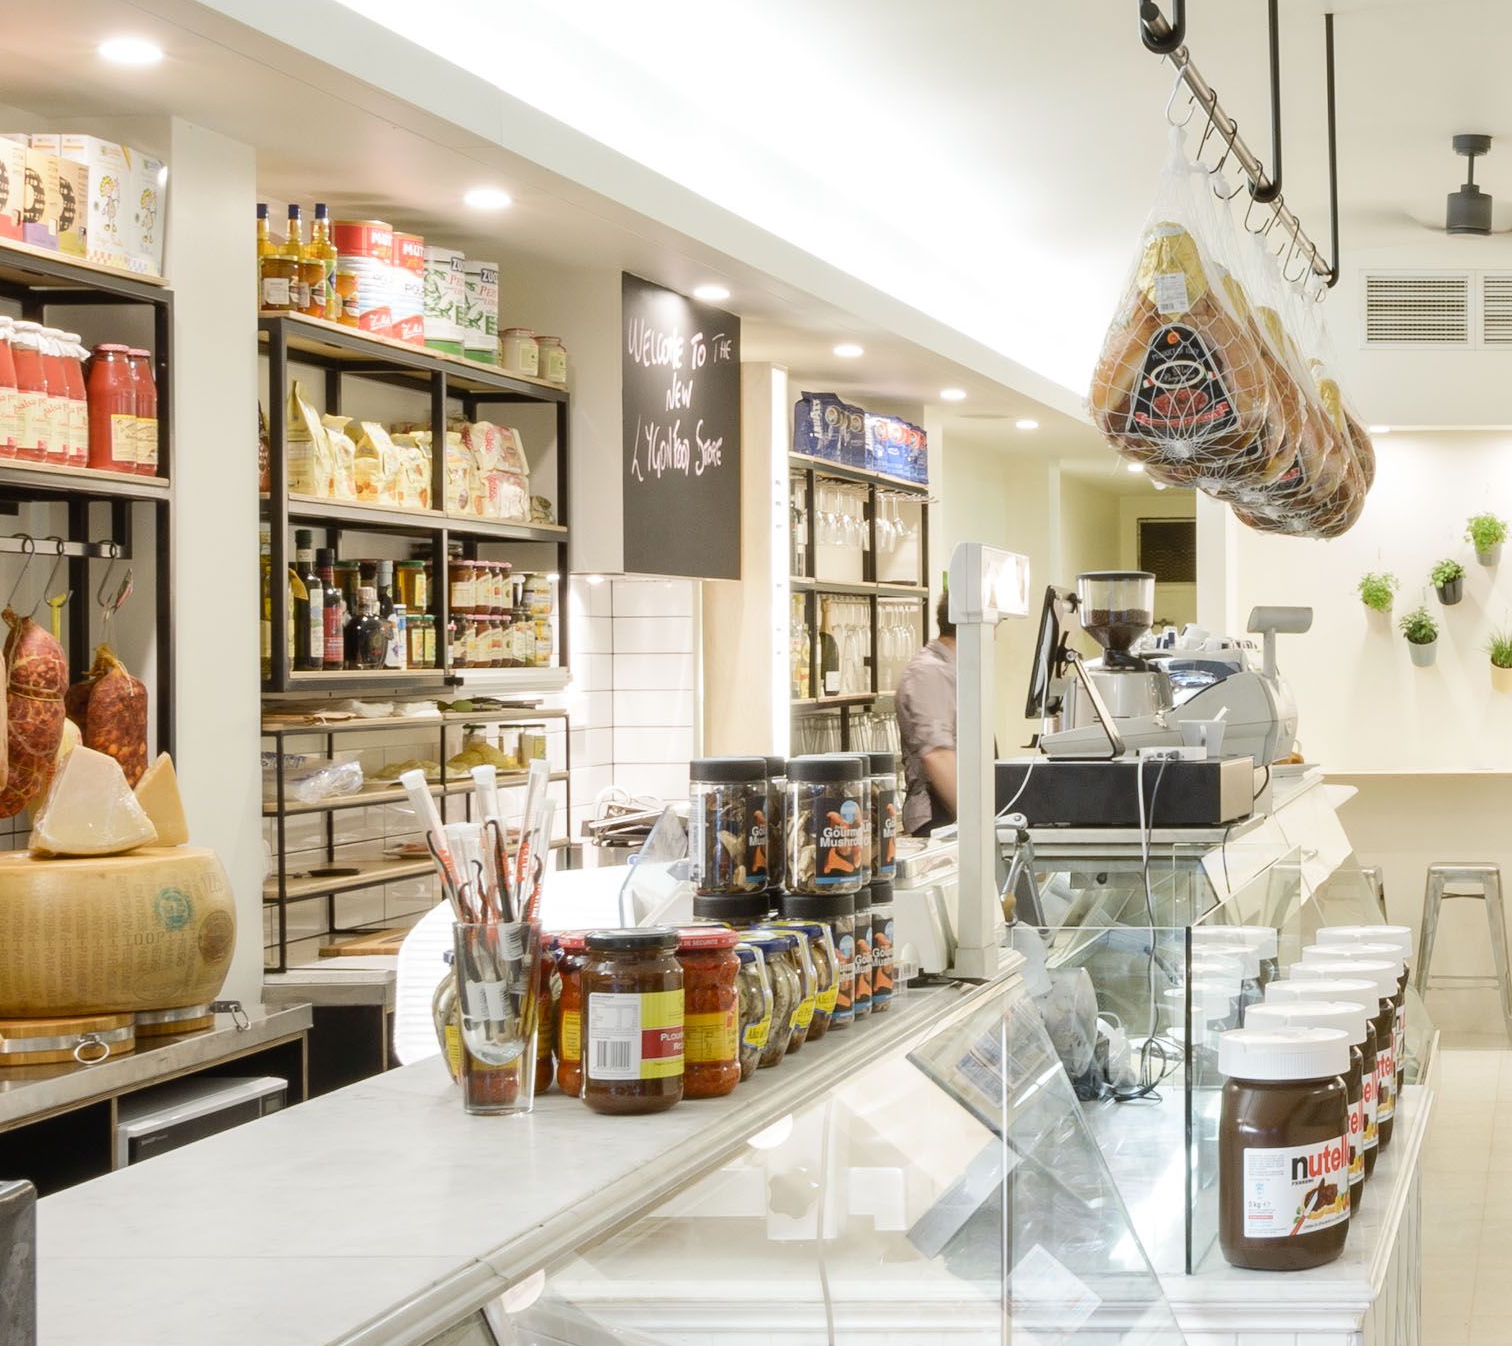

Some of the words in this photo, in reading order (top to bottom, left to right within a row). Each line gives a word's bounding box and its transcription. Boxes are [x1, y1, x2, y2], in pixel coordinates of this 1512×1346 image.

[628, 317, 684, 370] WELCOME
[691, 332, 707, 370] TO
[712, 333, 732, 363] THE
[666, 372, 693, 411] NEW
[695, 419, 723, 476] STORE
[823, 826, 862, 839] Gourm
